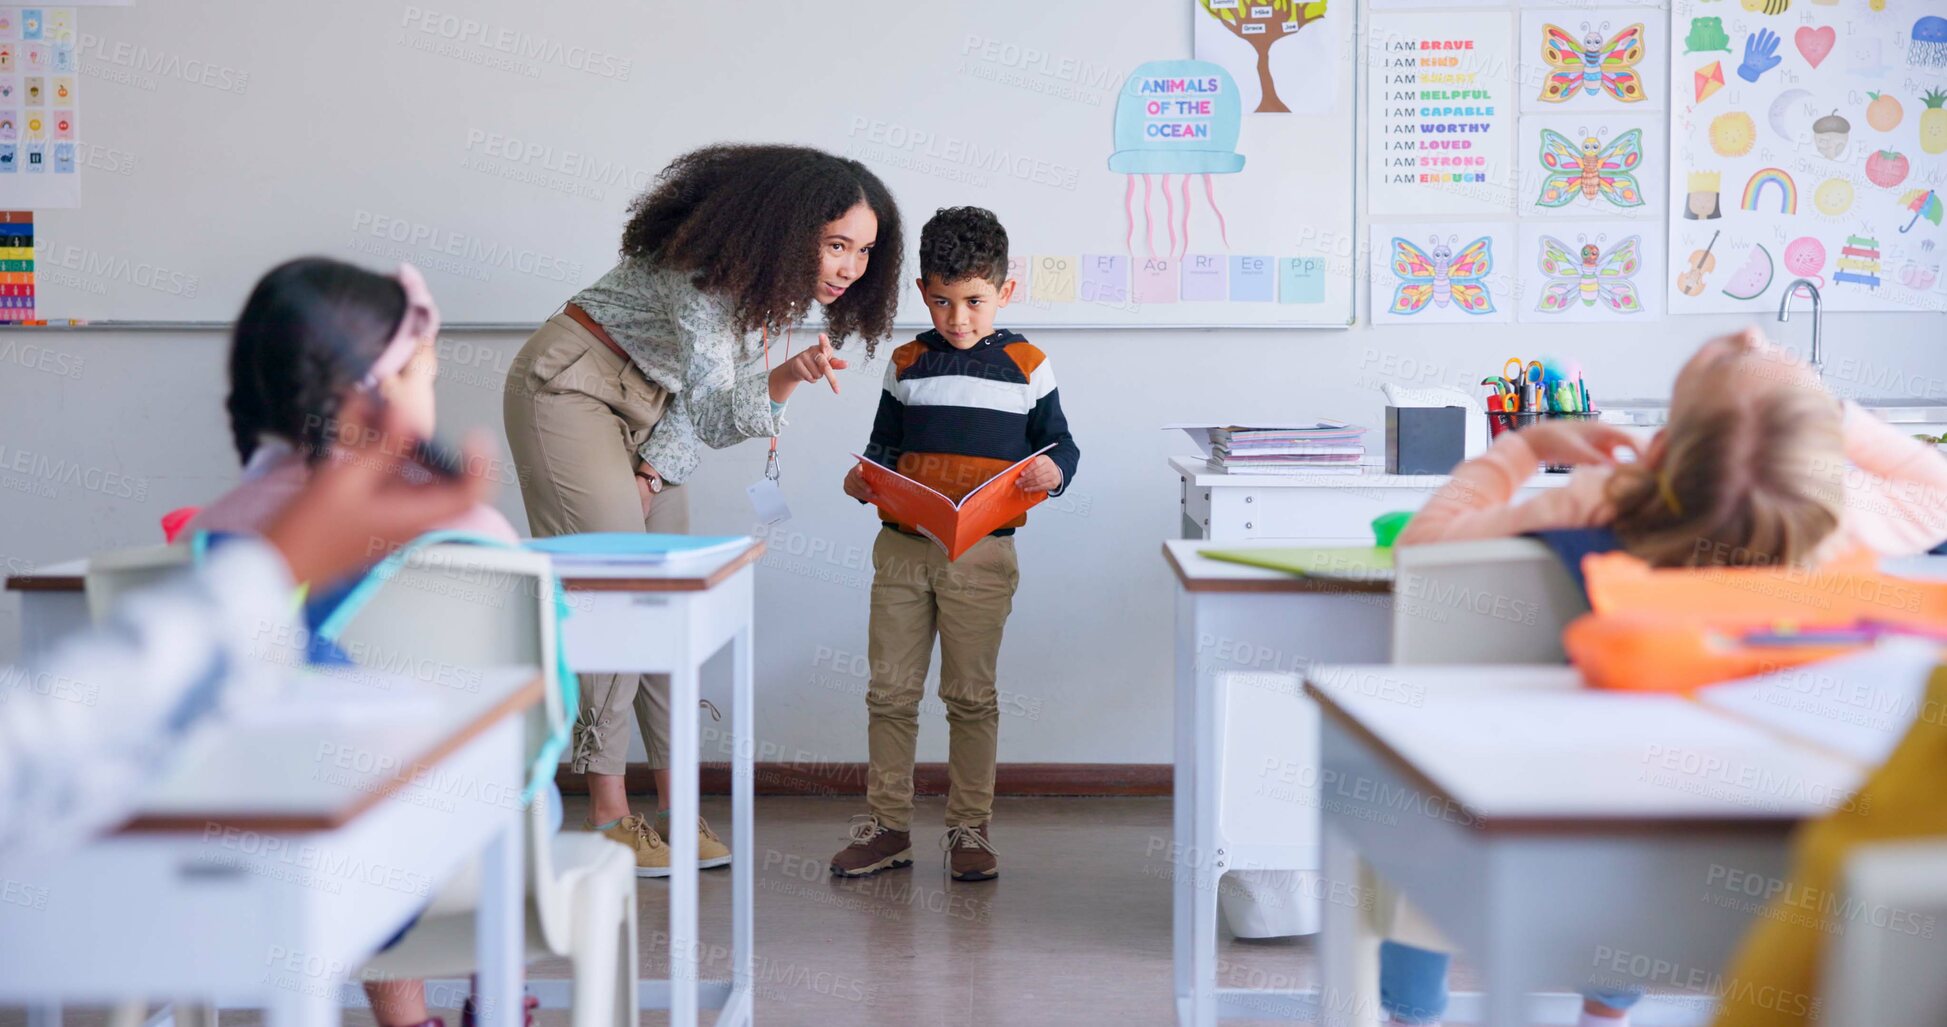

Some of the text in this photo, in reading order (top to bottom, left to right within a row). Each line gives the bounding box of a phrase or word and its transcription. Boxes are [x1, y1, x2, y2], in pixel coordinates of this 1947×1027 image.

[1284, 23, 1297, 31] Joe
[1394, 42, 1416, 50] AM
[1420, 41, 1474, 50] BRAVE
[1394, 59, 1416, 67] AM
[1421, 58, 1459, 67] KIND
[1394, 75, 1416, 83] AM
[1141, 78, 1218, 94] ANIMALS
[1394, 92, 1416, 100] AM
[1420, 91, 1491, 100] HELPFUL
[1147, 100, 1211, 115] OF THE
[1394, 109, 1416, 117] AM
[1420, 107, 1494, 117] CAPABLE
[1146, 124, 1207, 138] OCEAN
[1394, 125, 1416, 133] AM
[1420, 124, 1490, 133] WORTHY
[1394, 142, 1416, 150] AM
[1420, 141, 1472, 149] LOVED
[1394, 158, 1416, 167] AM
[1420, 157, 1485, 166] STRONG
[1394, 175, 1416, 183] AM
[1420, 174, 1485, 182] ENOUGH
[1042, 256, 1067, 271] Oo
[1098, 256, 1115, 270] Ff
[1144, 259, 1167, 271] Aa
[1196, 256, 1214, 268] Rr
[1242, 257, 1264, 270] Ee
[1292, 258, 1315, 273] Pp
